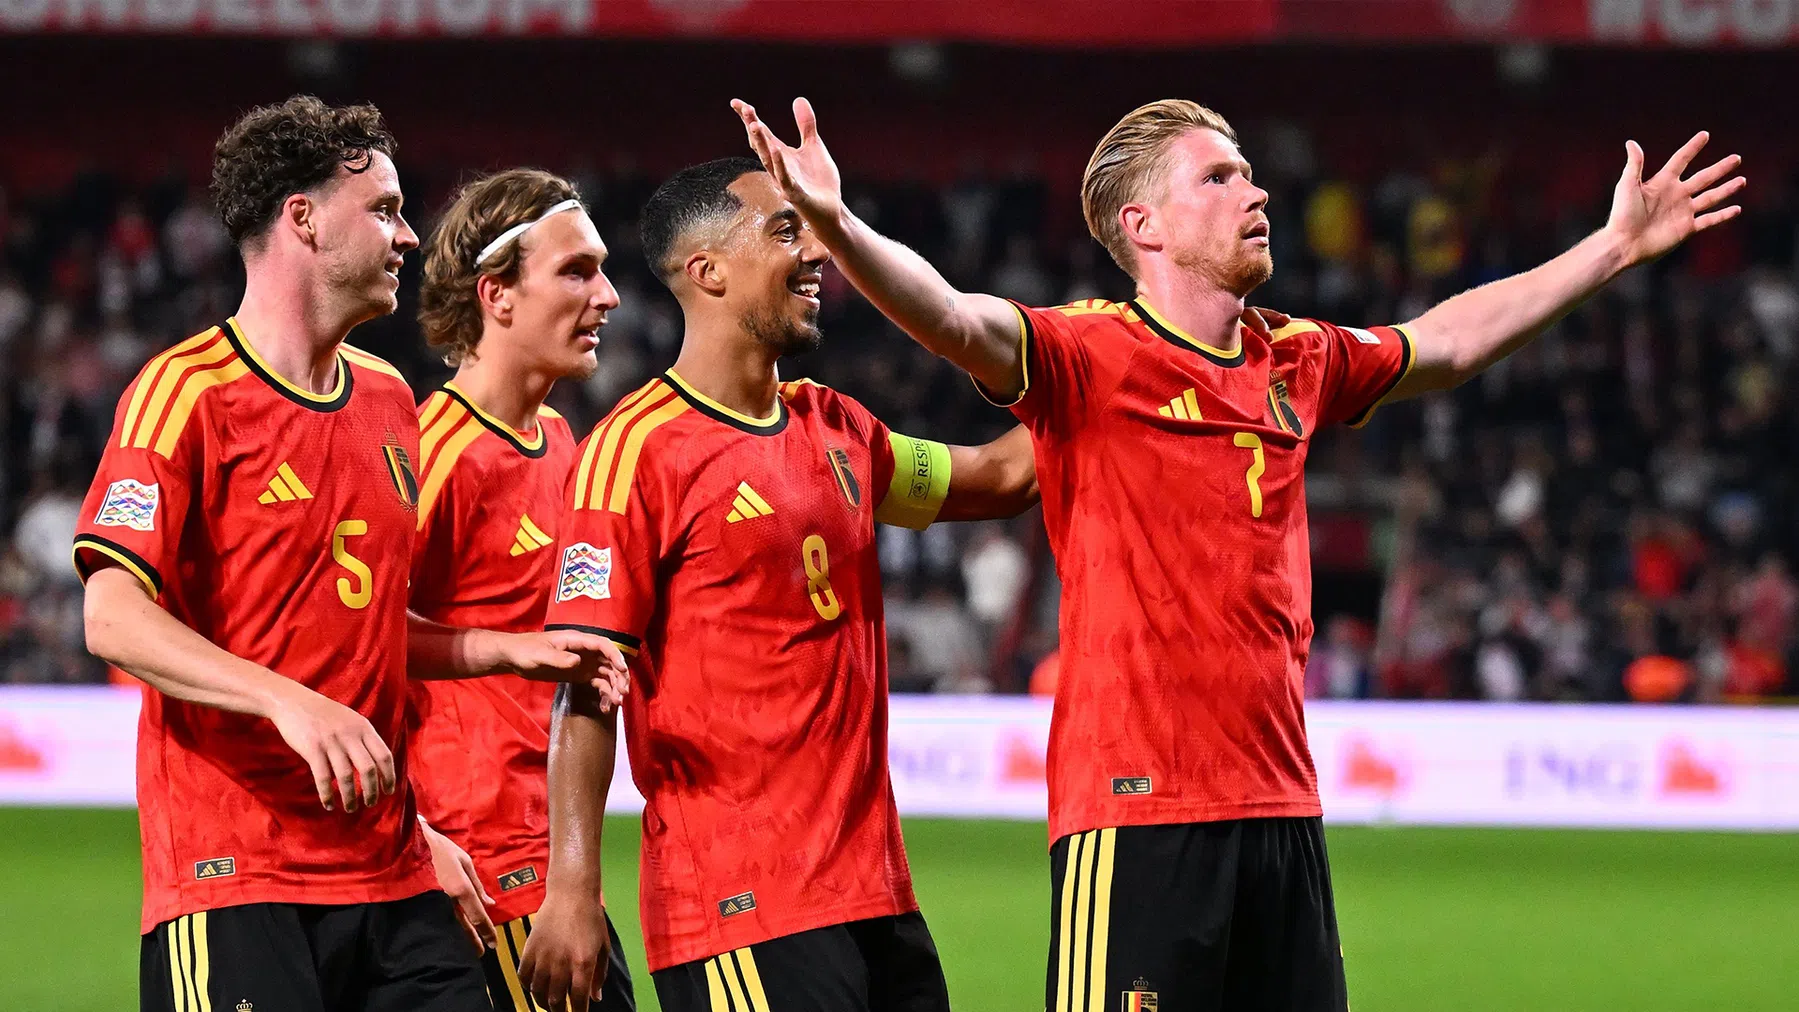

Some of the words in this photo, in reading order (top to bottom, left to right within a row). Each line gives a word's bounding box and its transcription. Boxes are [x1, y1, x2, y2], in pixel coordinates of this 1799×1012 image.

[1233, 432, 1266, 518] 7
[332, 519, 373, 610] 5
[802, 534, 840, 621] 8
